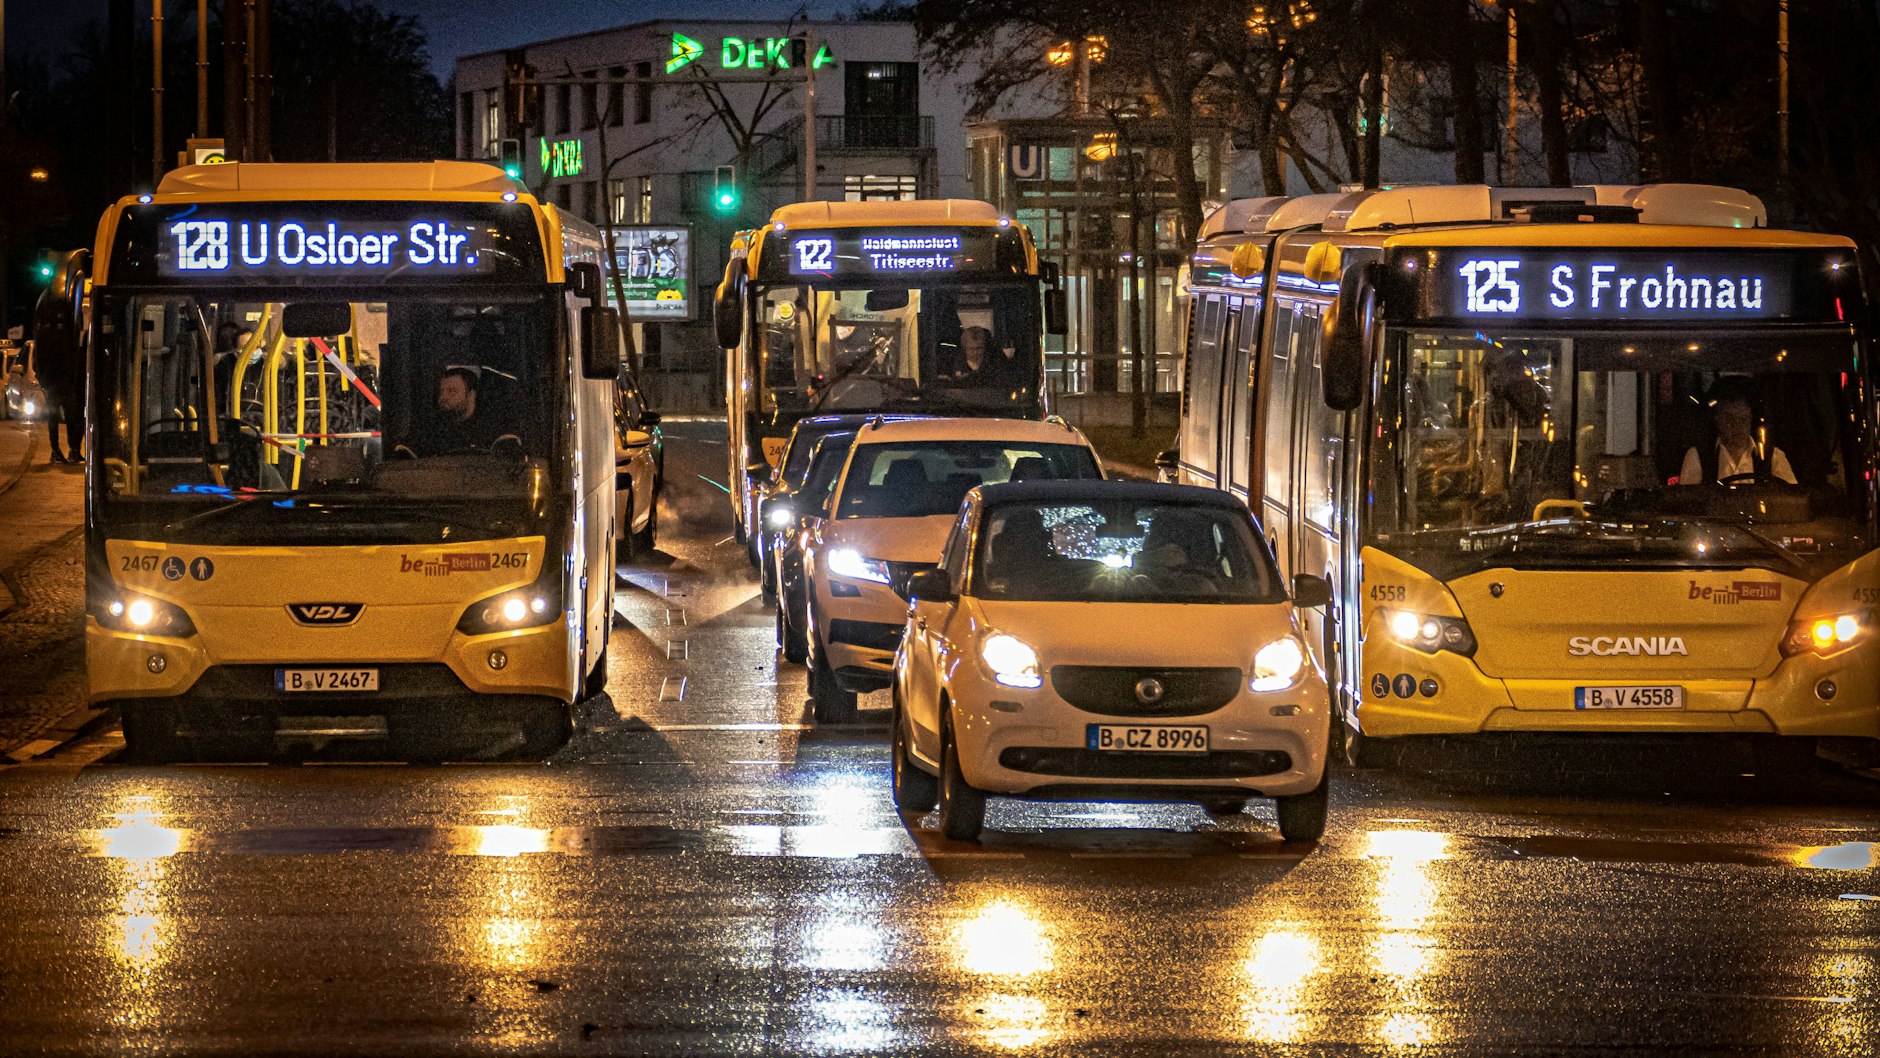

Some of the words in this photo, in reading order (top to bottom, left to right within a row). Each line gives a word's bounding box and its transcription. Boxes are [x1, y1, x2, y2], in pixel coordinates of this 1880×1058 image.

[1012, 145, 1037, 177] U
[171, 221, 229, 270] 128
[241, 223, 268, 265] U
[278, 222, 398, 265] Osloer
[408, 222, 475, 265] Str.
[795, 239, 832, 270] 122
[870, 253, 954, 269] Titiseestr.
[1459, 260, 1520, 312] 125
[1550, 265, 1575, 308] S
[1591, 265, 1762, 309] Frohnau
[769, 446, 783, 456] 24
[121, 555, 159, 572] 2467
[451, 557, 487, 569] Berlin
[491, 553, 529, 569] 2467
[1370, 585, 1406, 601] 4558
[1741, 586, 1778, 598] Berlin
[300, 606, 351, 619] VDL
[1568, 636, 1689, 656] SCANIA
[292, 672, 302, 688] B
[314, 672, 325, 688] V
[329, 672, 370, 688] 2467
[1591, 689, 1603, 706] B
[1615, 689, 1626, 706] V
[1631, 688, 1674, 706] 4558
[1100, 728, 1113, 747] B
[1126, 729, 1152, 748] CZ
[1157, 729, 1205, 748] 8996
